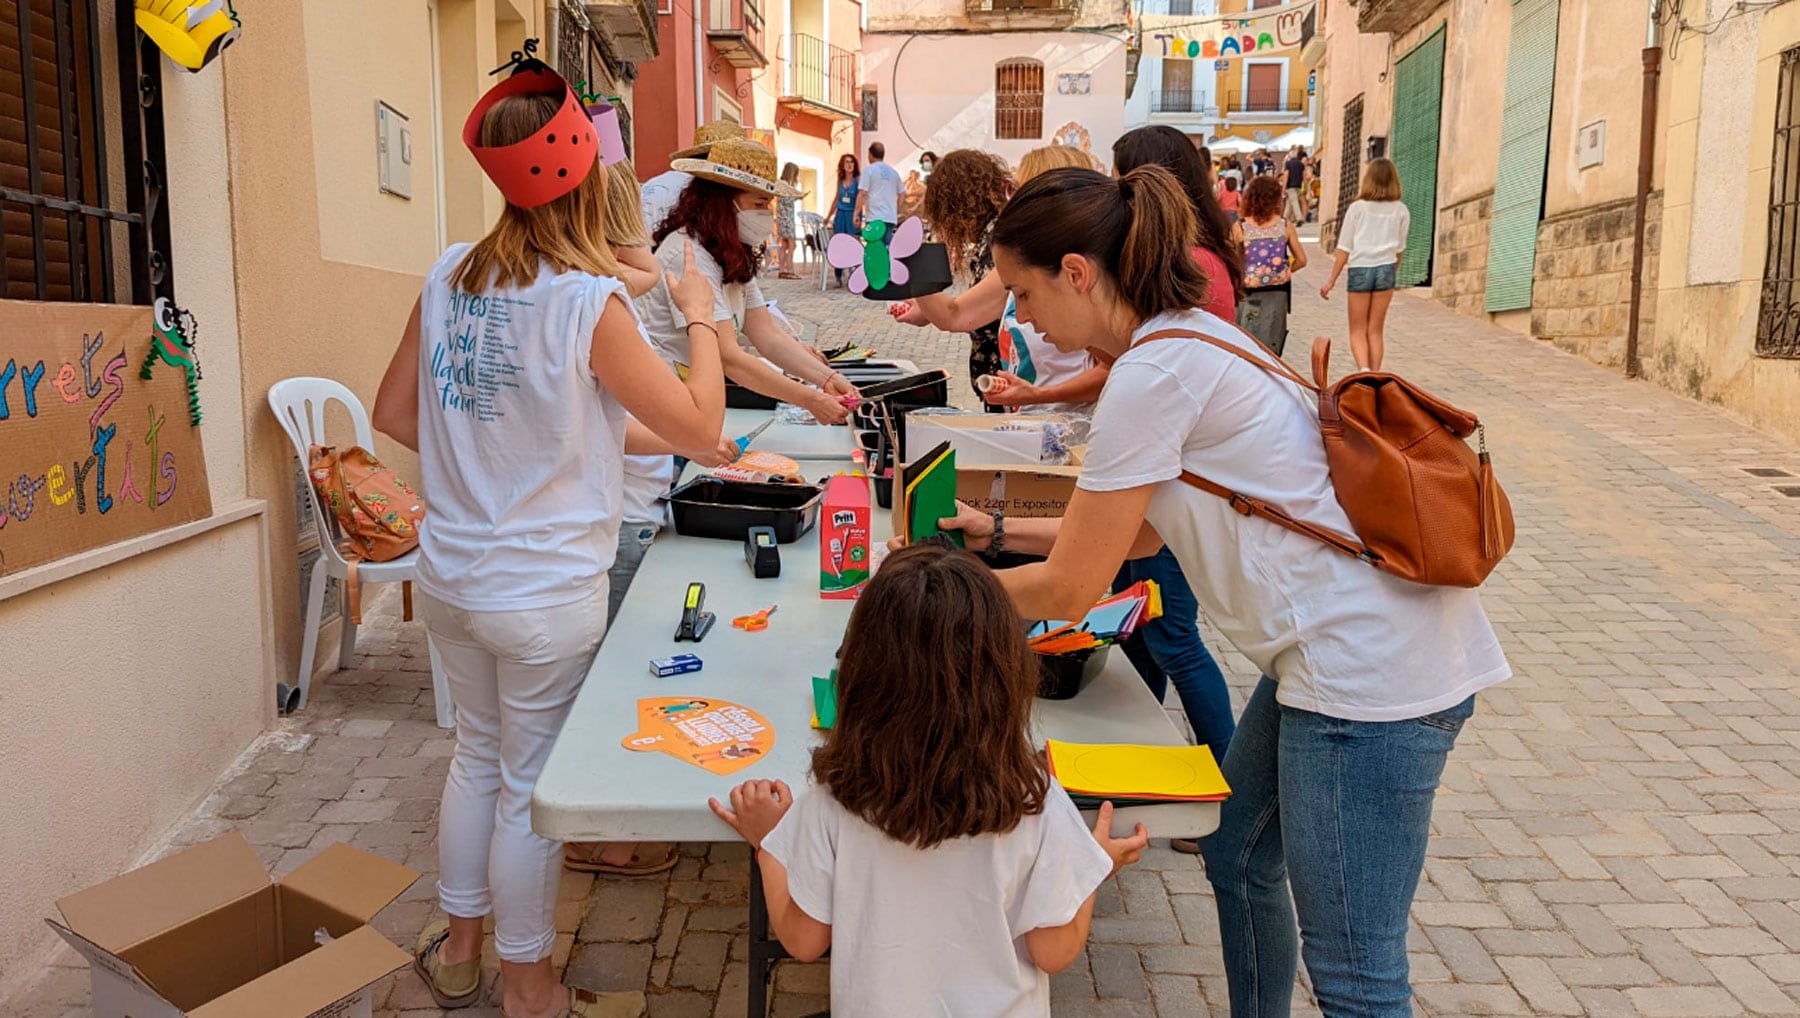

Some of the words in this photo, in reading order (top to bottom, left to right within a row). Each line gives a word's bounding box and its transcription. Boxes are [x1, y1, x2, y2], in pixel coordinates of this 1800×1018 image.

[1154, 32, 1274, 58] TROBADA
[984, 499, 1010, 511] 22gr
[1013, 499, 1069, 510] Expositor
[833, 512, 854, 524] Pritt
